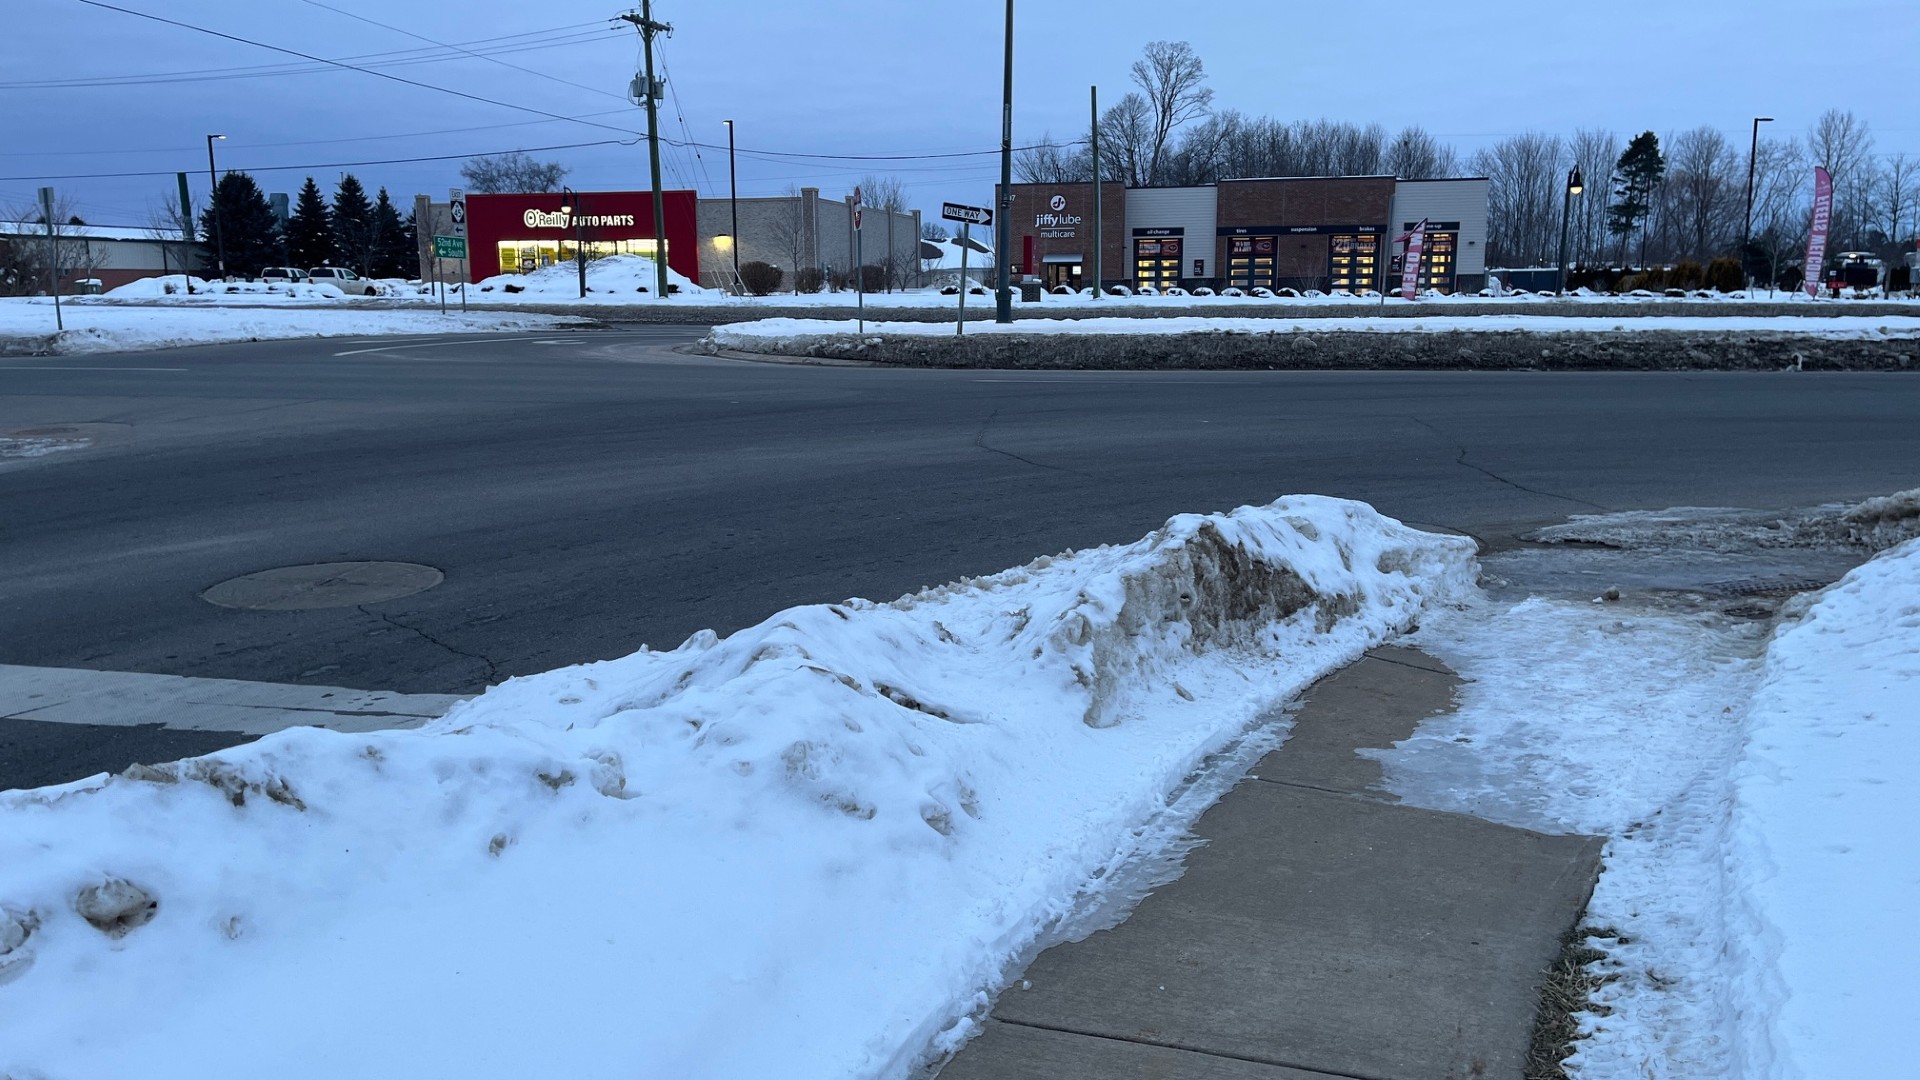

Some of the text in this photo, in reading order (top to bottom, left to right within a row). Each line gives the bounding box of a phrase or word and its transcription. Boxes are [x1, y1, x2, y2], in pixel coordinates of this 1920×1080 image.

[454, 208, 462, 218] 45
[524, 209, 635, 228] O'Reilly AUTO PARTS
[946, 207, 980, 219] ONE WAY
[1035, 213, 1082, 228] jiffy lube
[1040, 230, 1075, 238] multicare
[437, 237, 464, 248] 52nd Ave
[447, 248, 464, 258] South
